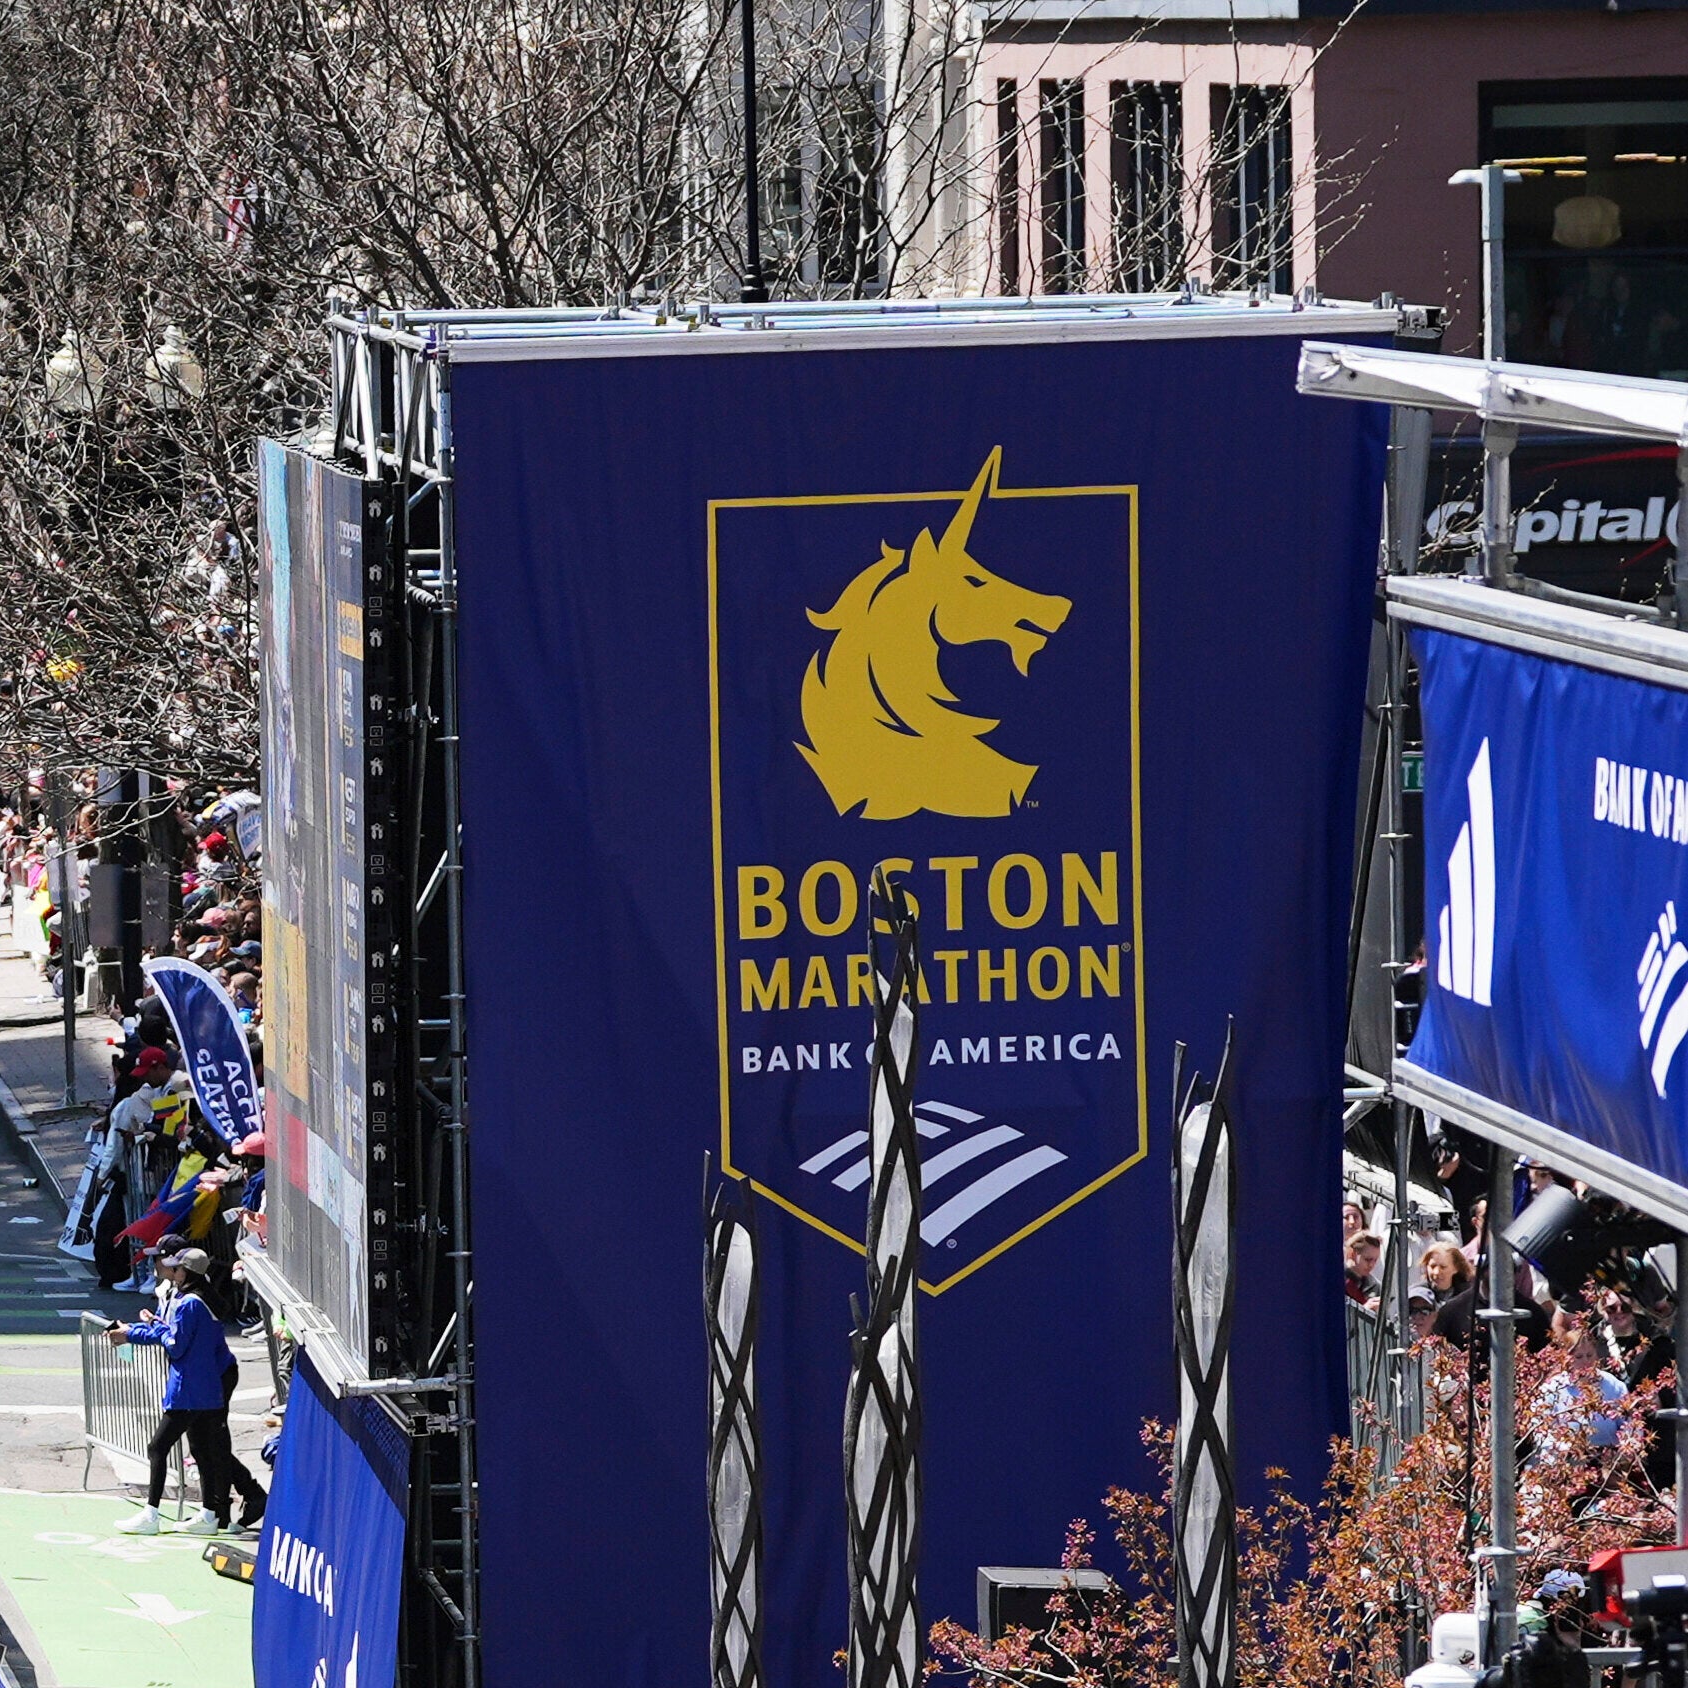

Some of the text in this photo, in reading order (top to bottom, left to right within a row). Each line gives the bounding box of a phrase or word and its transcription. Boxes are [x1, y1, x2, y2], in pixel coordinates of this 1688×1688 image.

[1594, 757, 1647, 833] BANK
[737, 851, 1119, 940] BOSTON
[742, 1032, 1122, 1074] BANK AMERICA
